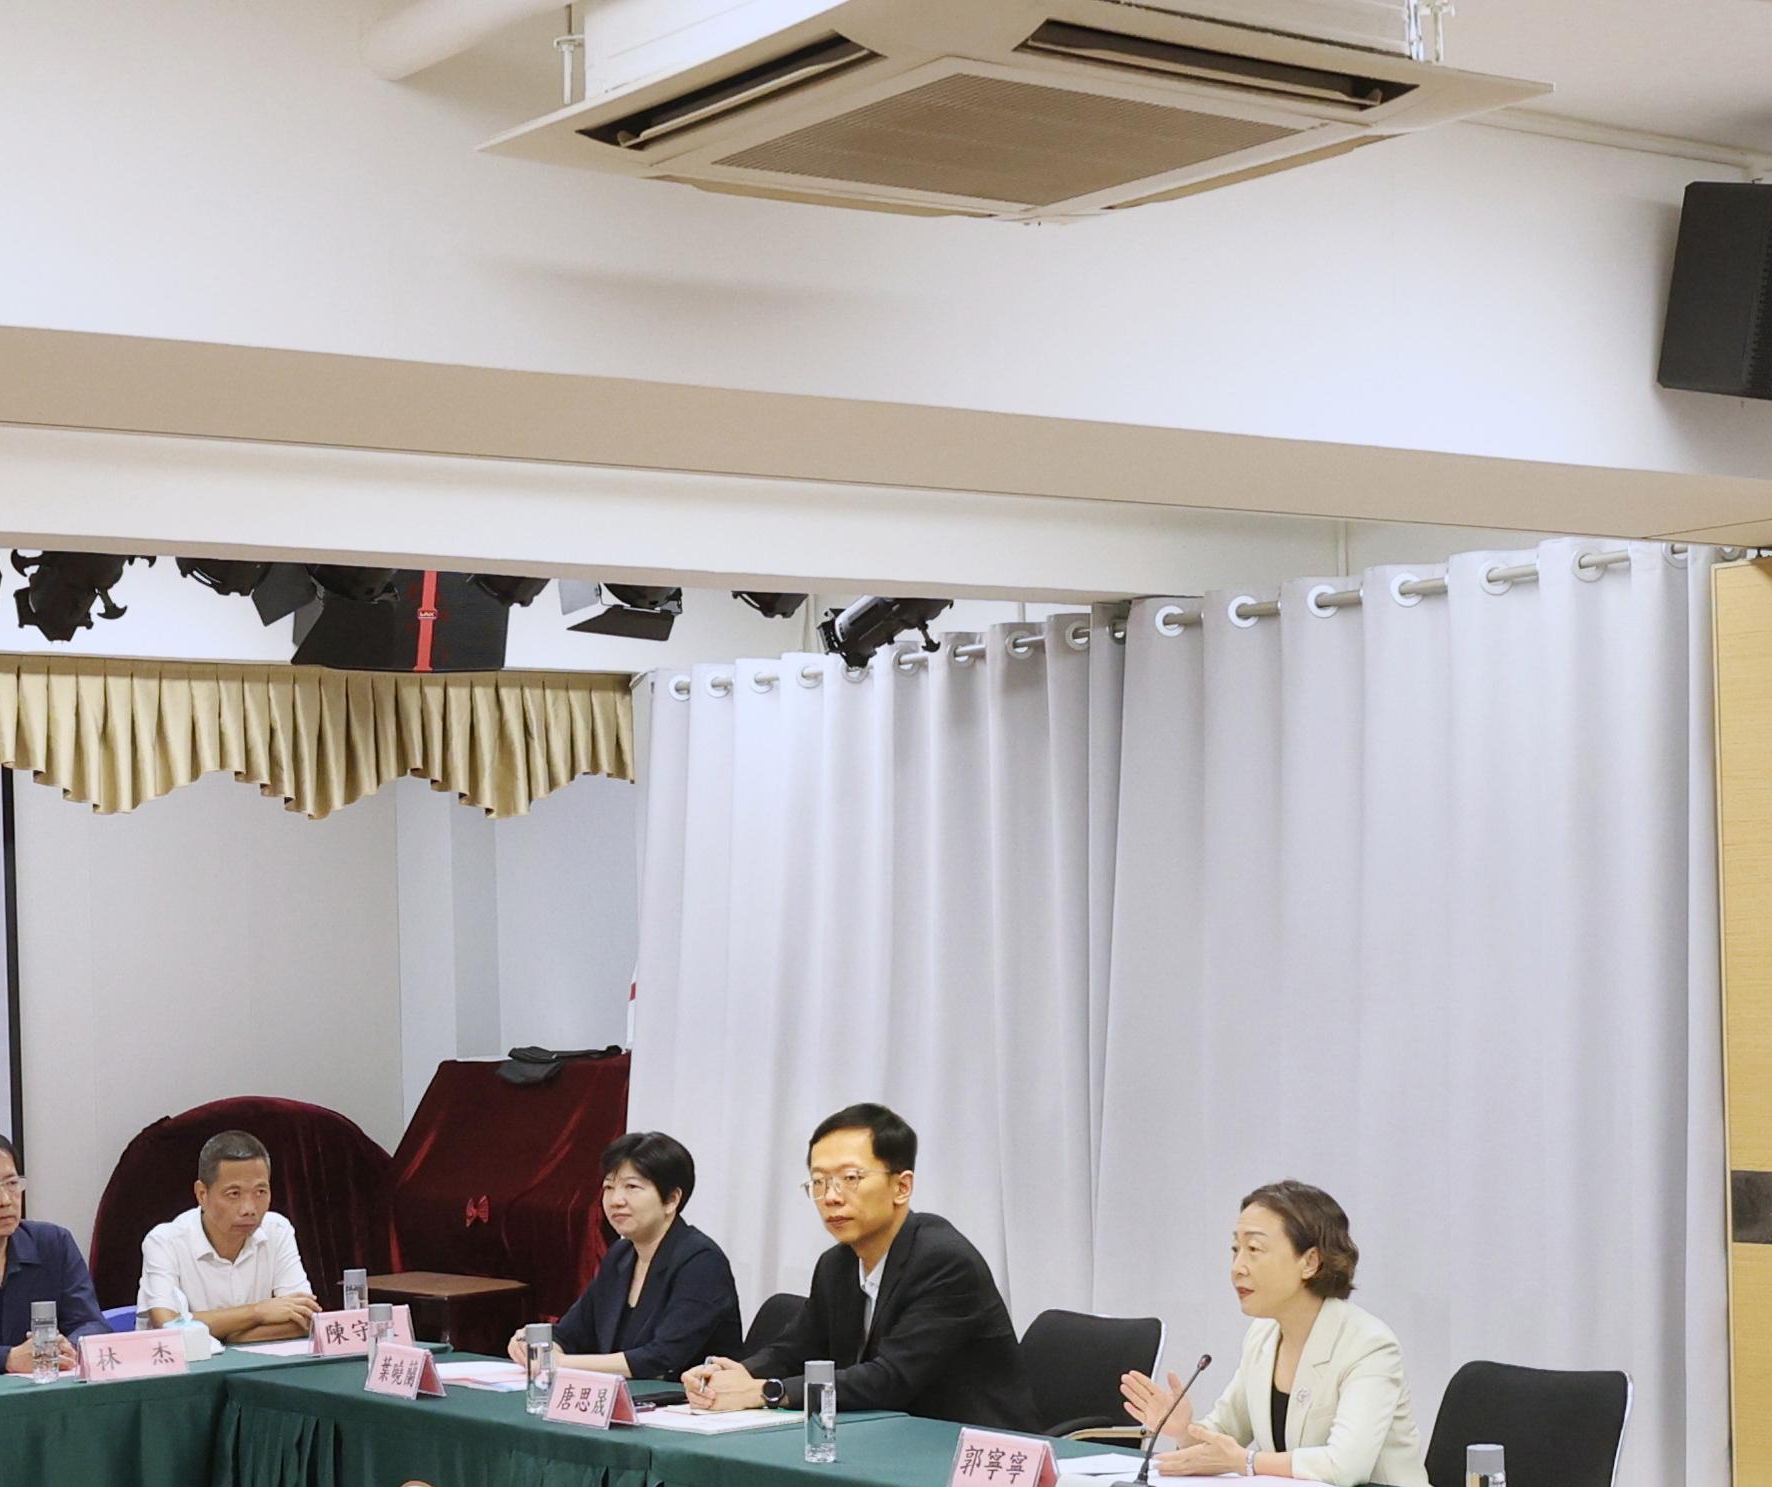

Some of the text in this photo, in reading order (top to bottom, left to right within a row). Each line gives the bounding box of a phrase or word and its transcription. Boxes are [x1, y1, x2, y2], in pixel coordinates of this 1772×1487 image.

[325, 1320, 399, 1345] 陳守
[960, 1445, 1027, 1485] 郭寧寧
